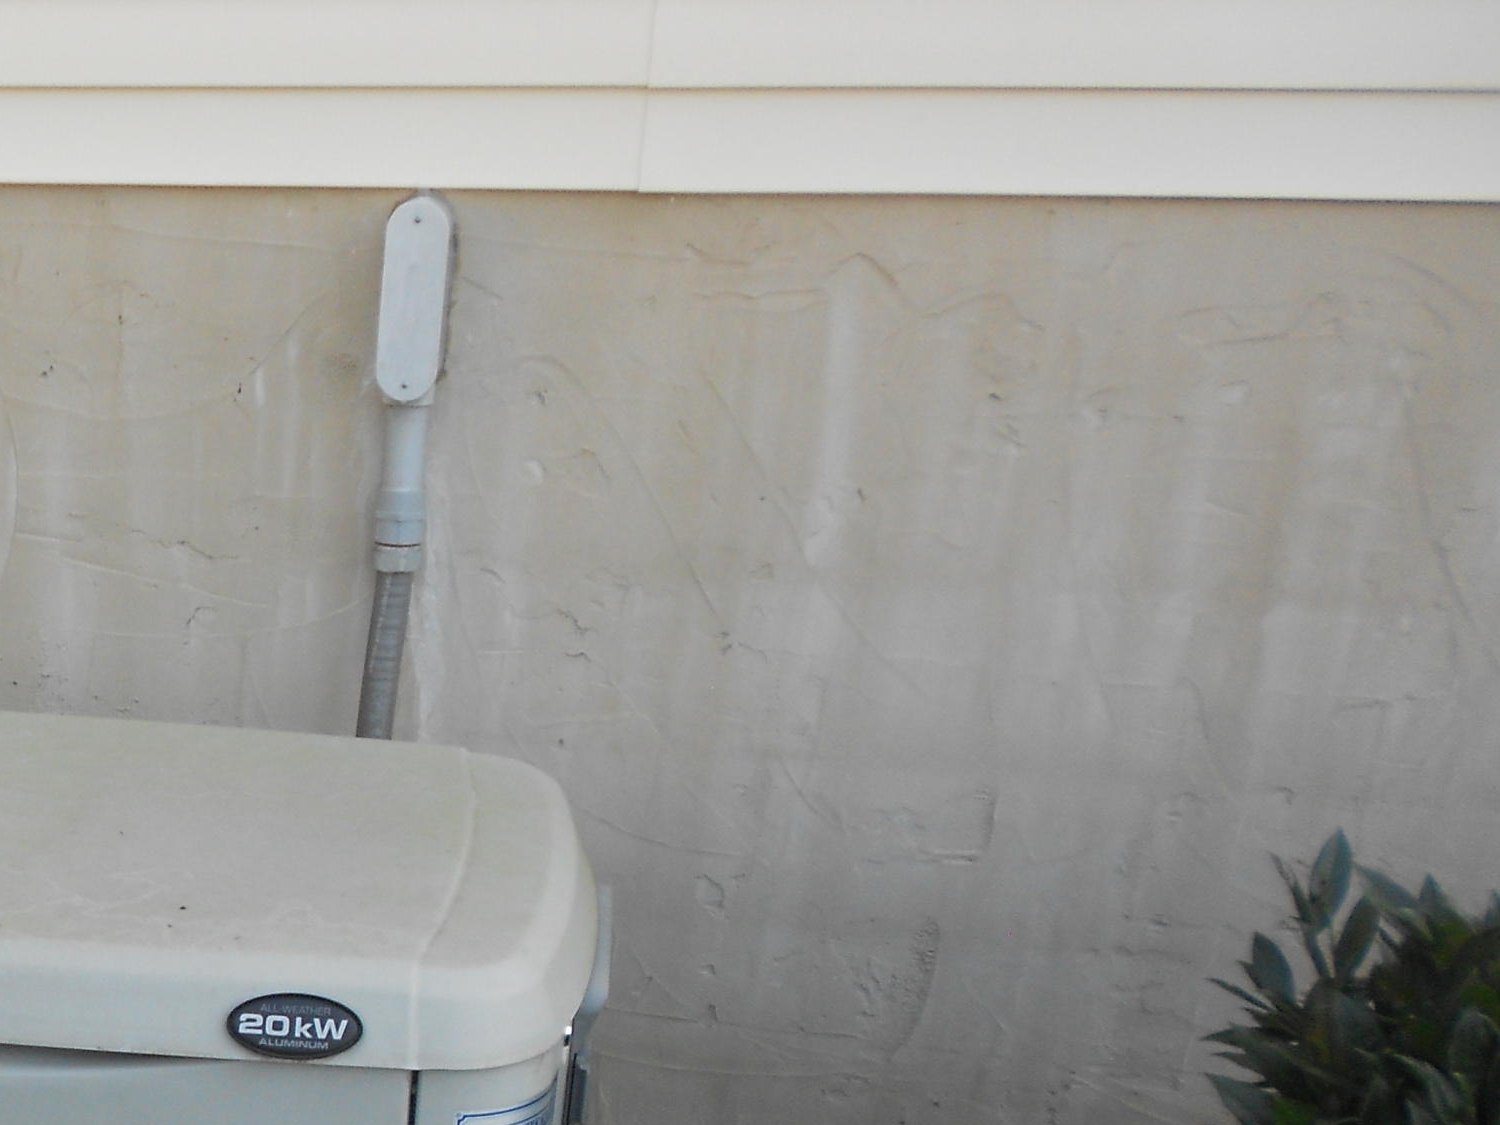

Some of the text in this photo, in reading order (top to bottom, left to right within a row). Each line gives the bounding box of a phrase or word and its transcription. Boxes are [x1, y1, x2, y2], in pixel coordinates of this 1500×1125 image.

[260, 1003, 332, 1016] ALL WEATHER
[238, 1013, 348, 1040] 20 kW
[258, 1038, 329, 1050] ALUMINUM
